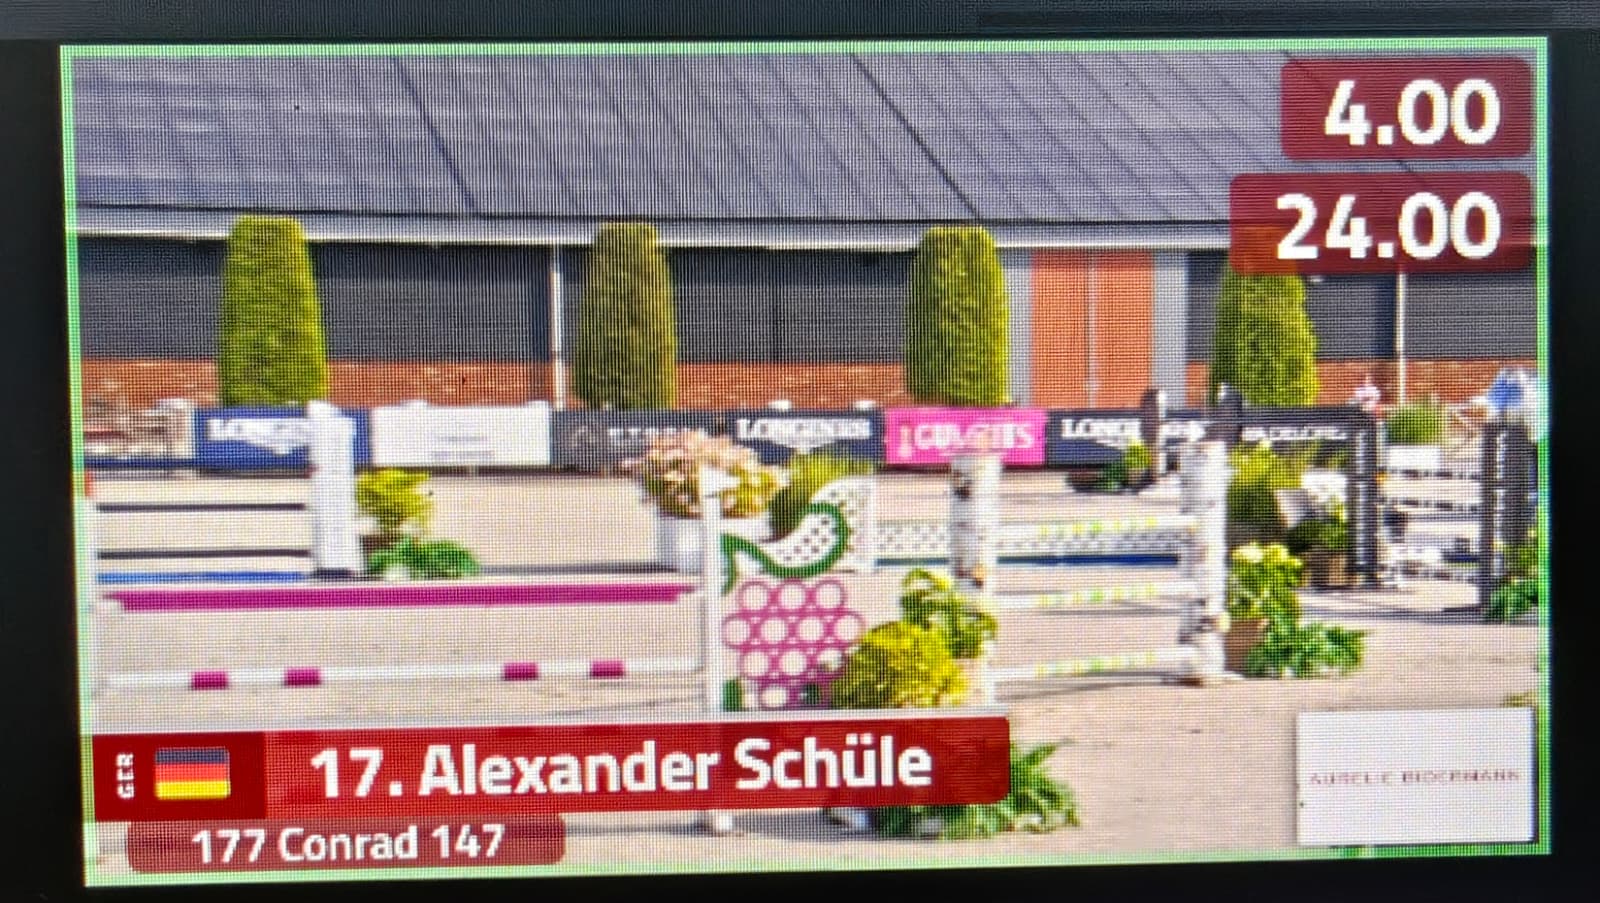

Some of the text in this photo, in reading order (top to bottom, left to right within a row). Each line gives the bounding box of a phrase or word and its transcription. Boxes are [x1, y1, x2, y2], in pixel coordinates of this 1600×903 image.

[1324, 79, 1500, 146] 4.00
[1276, 192, 1501, 259] 24.00
[116, 752, 135, 799] GER
[310, 733, 933, 798] 17. Alexander Schüle
[192, 823, 506, 864] 177 Conrad 147
